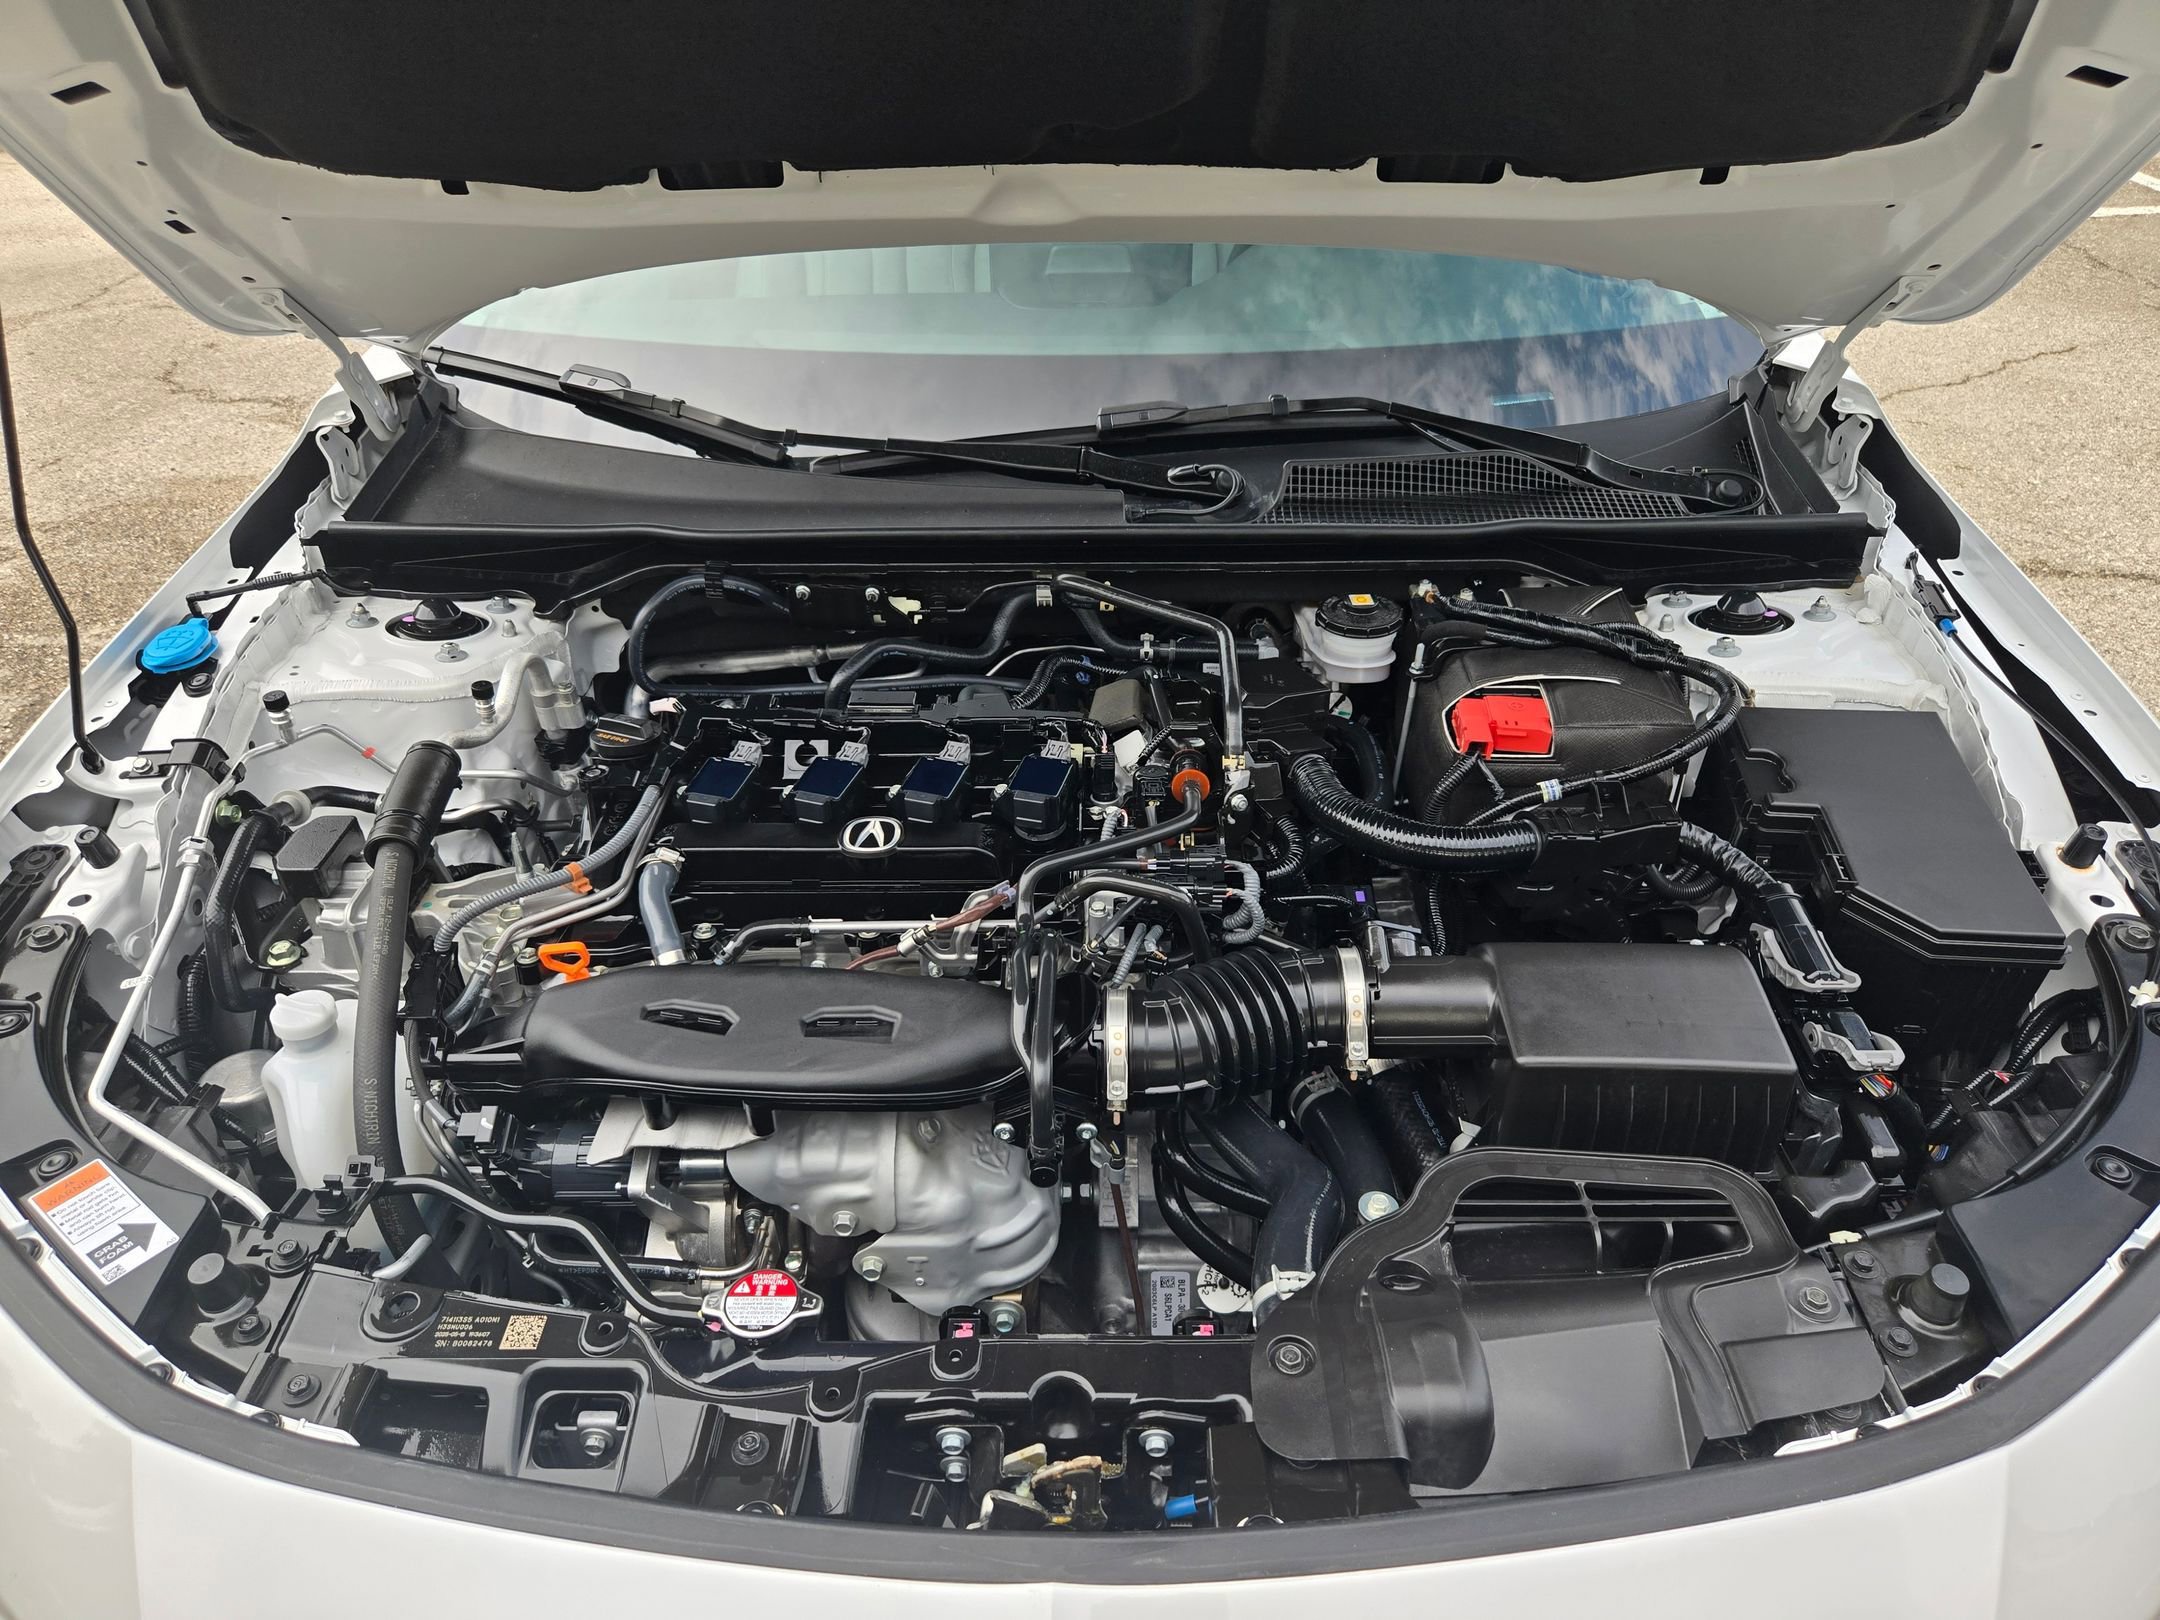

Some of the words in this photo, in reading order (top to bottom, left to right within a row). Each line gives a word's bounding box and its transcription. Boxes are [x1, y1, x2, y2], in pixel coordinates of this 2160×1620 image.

[46, 1175, 101, 1206] WARNING
[94, 1235, 129, 1258] GRAB
[98, 1240, 134, 1264] FOAM
